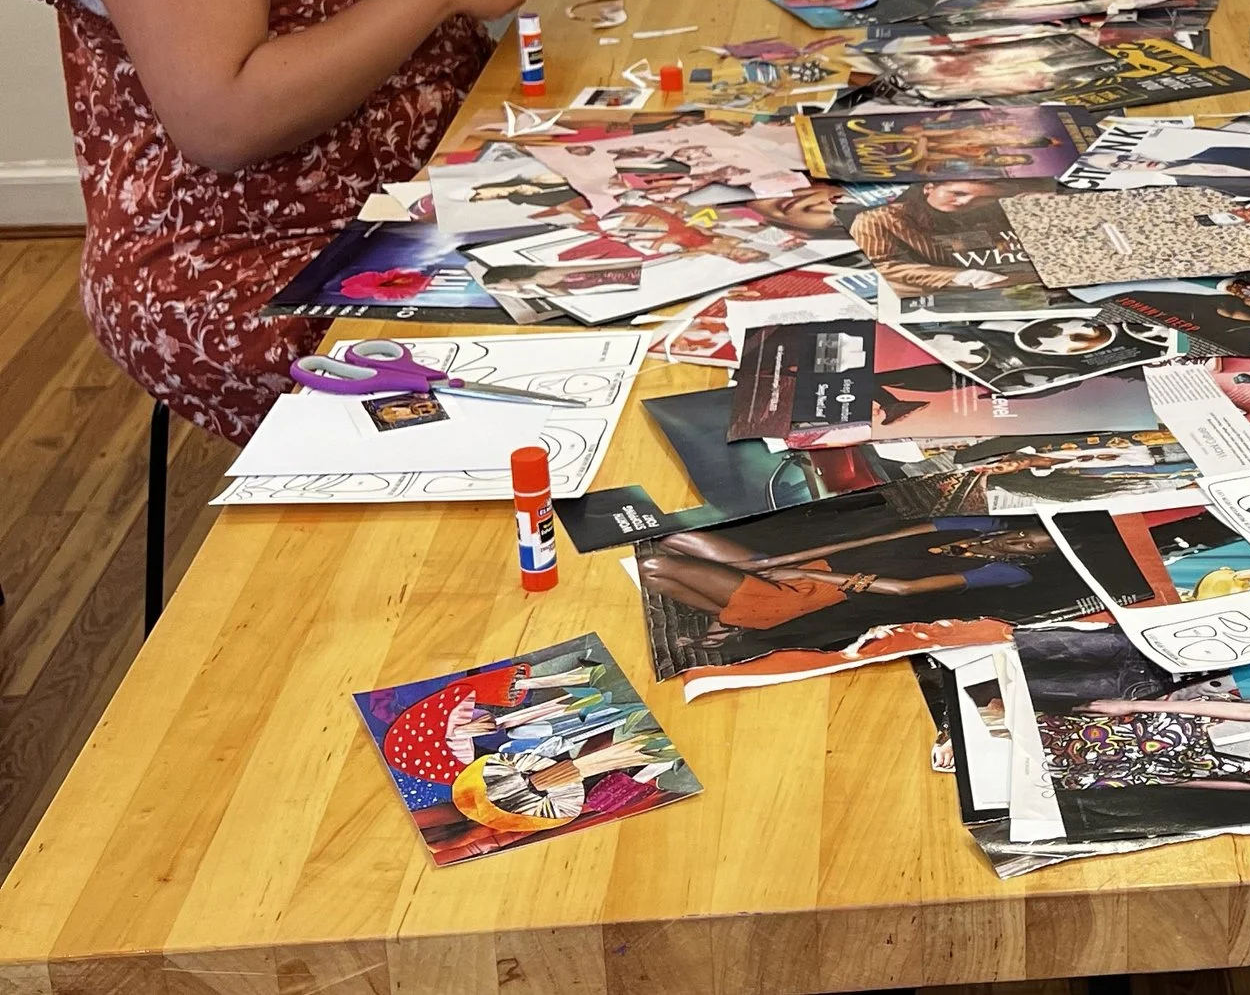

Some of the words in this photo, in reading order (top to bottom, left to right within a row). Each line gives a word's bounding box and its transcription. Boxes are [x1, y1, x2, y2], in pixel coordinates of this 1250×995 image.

[1115, 296, 1168, 318] JOHNNY
[1163, 316, 1201, 332] DEPP
[991, 393, 1018, 418] Level
